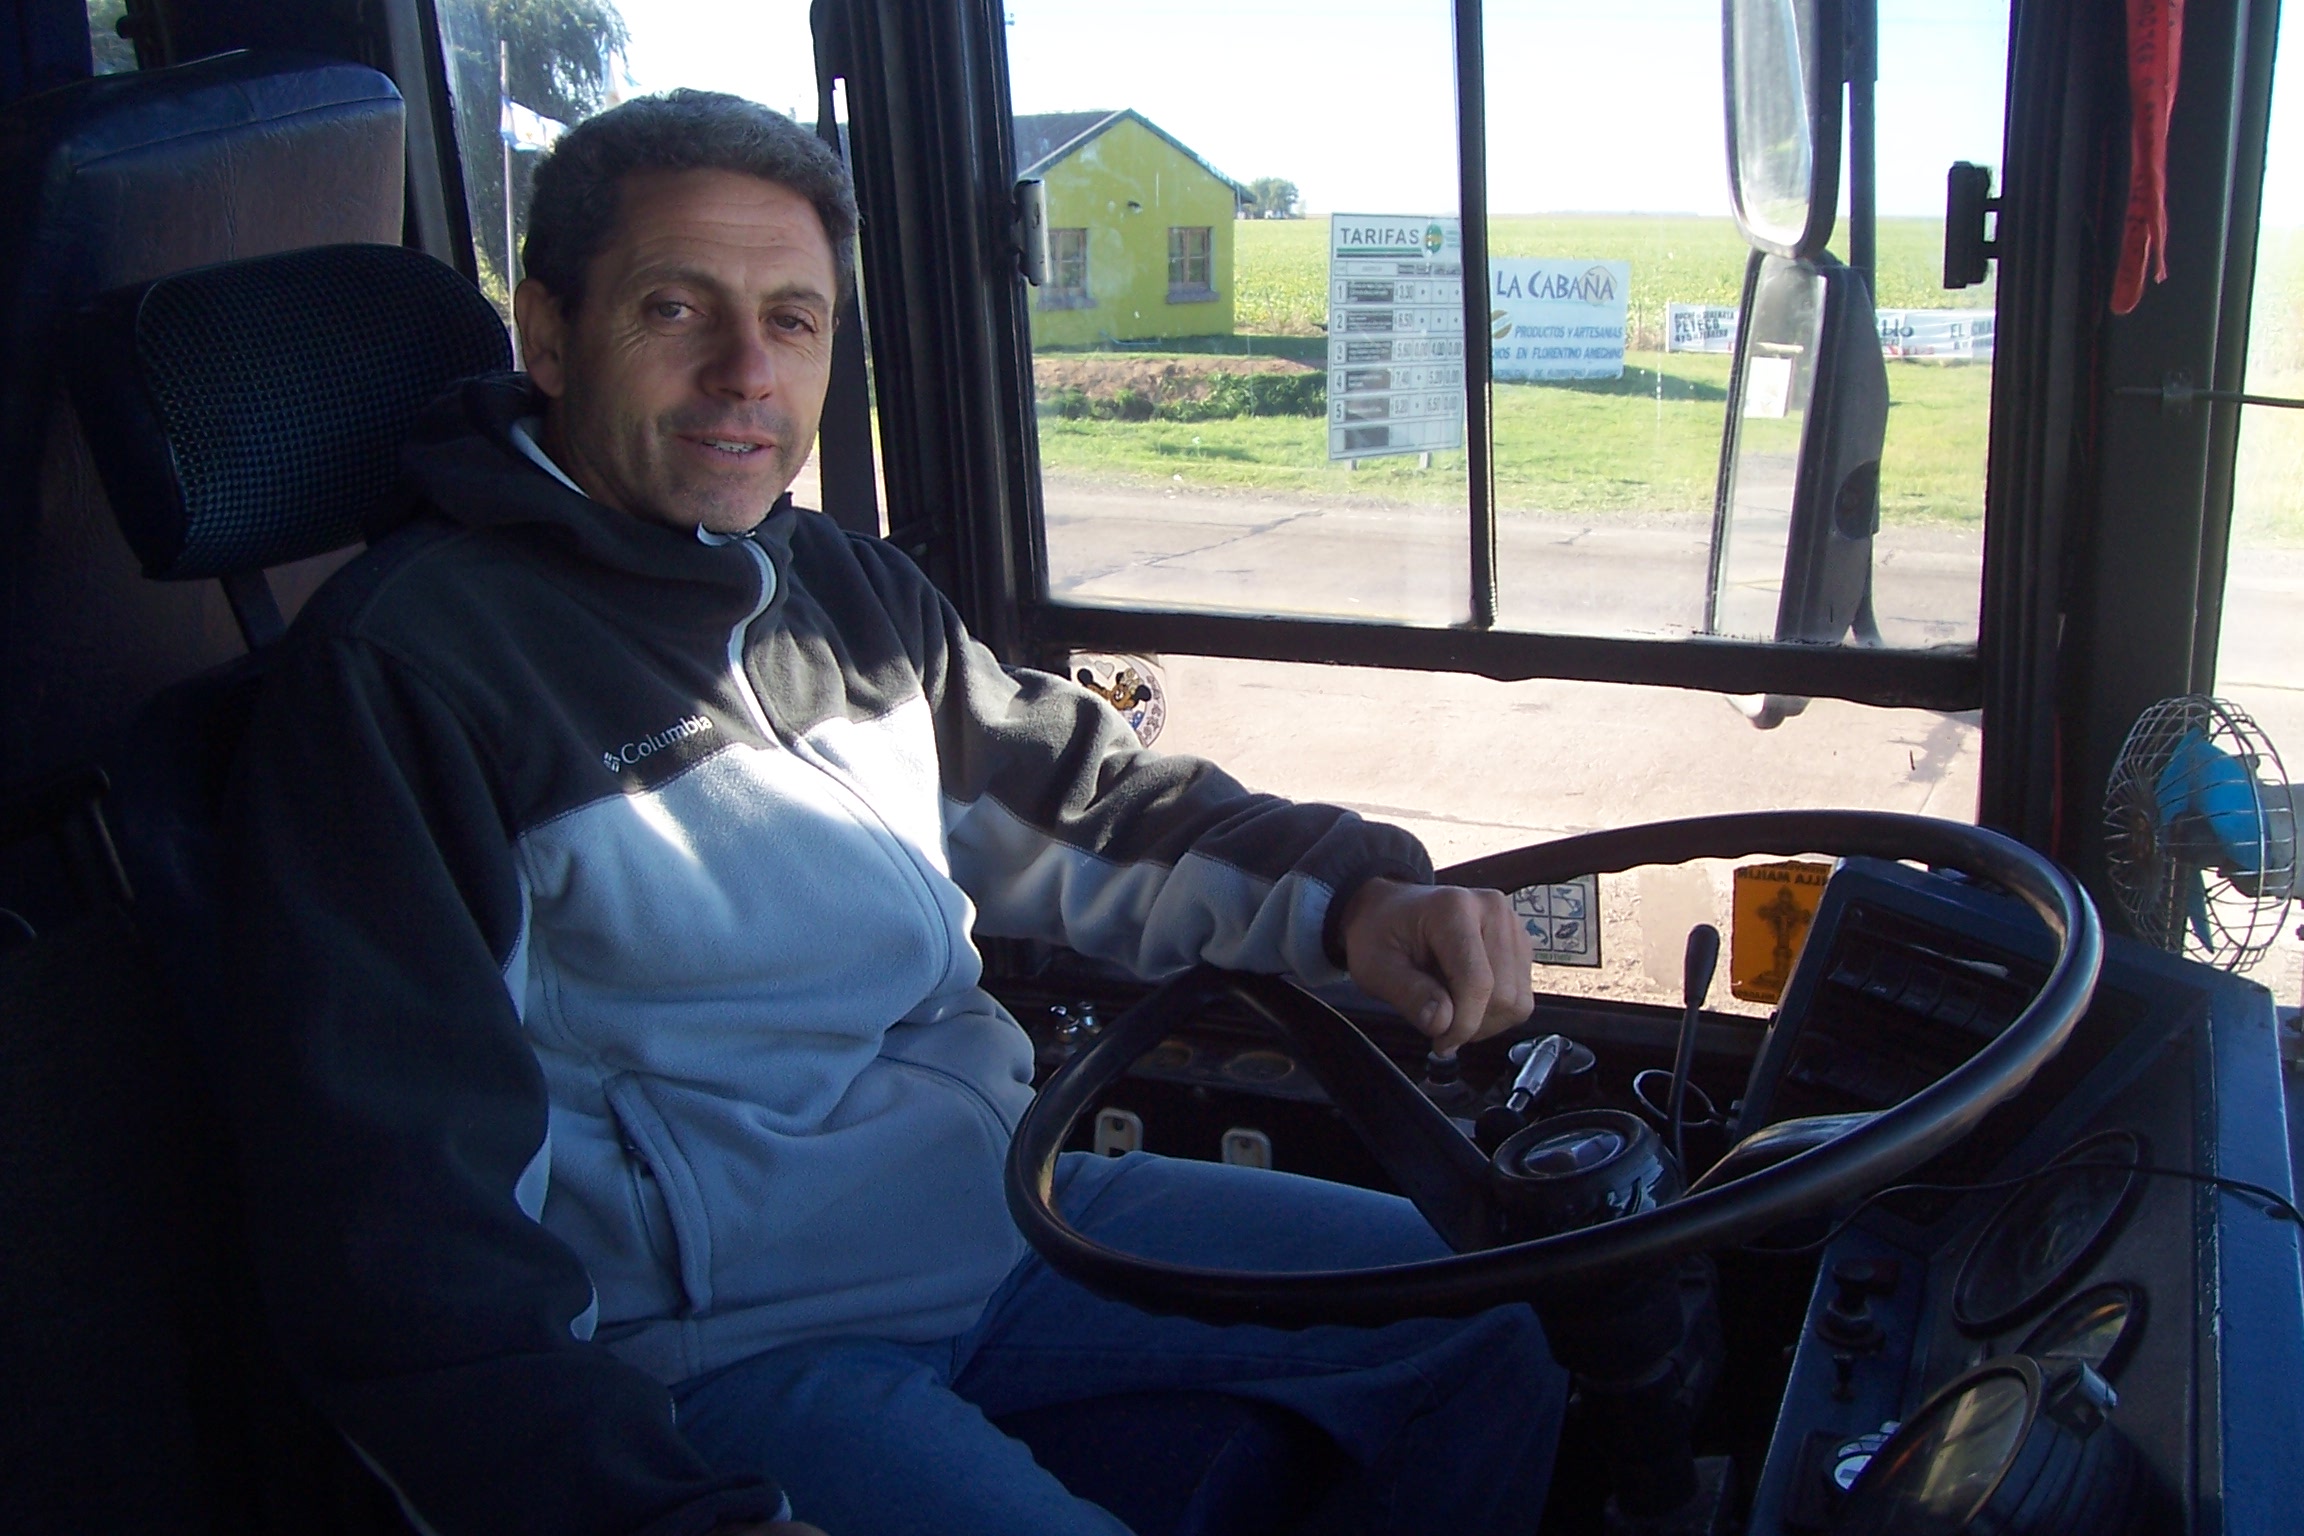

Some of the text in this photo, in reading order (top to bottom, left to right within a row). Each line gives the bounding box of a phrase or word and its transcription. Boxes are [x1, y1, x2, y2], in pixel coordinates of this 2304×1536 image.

[1340, 227, 1420, 245] TARIFAS
[1496, 270, 1615, 301] LA CABAÑA
[1336, 313, 1343, 329] 2
[1515, 326, 1565, 338] PRODUCTOS
[1516, 347, 1527, 359] EN
[621, 715, 713, 764] Columbia
